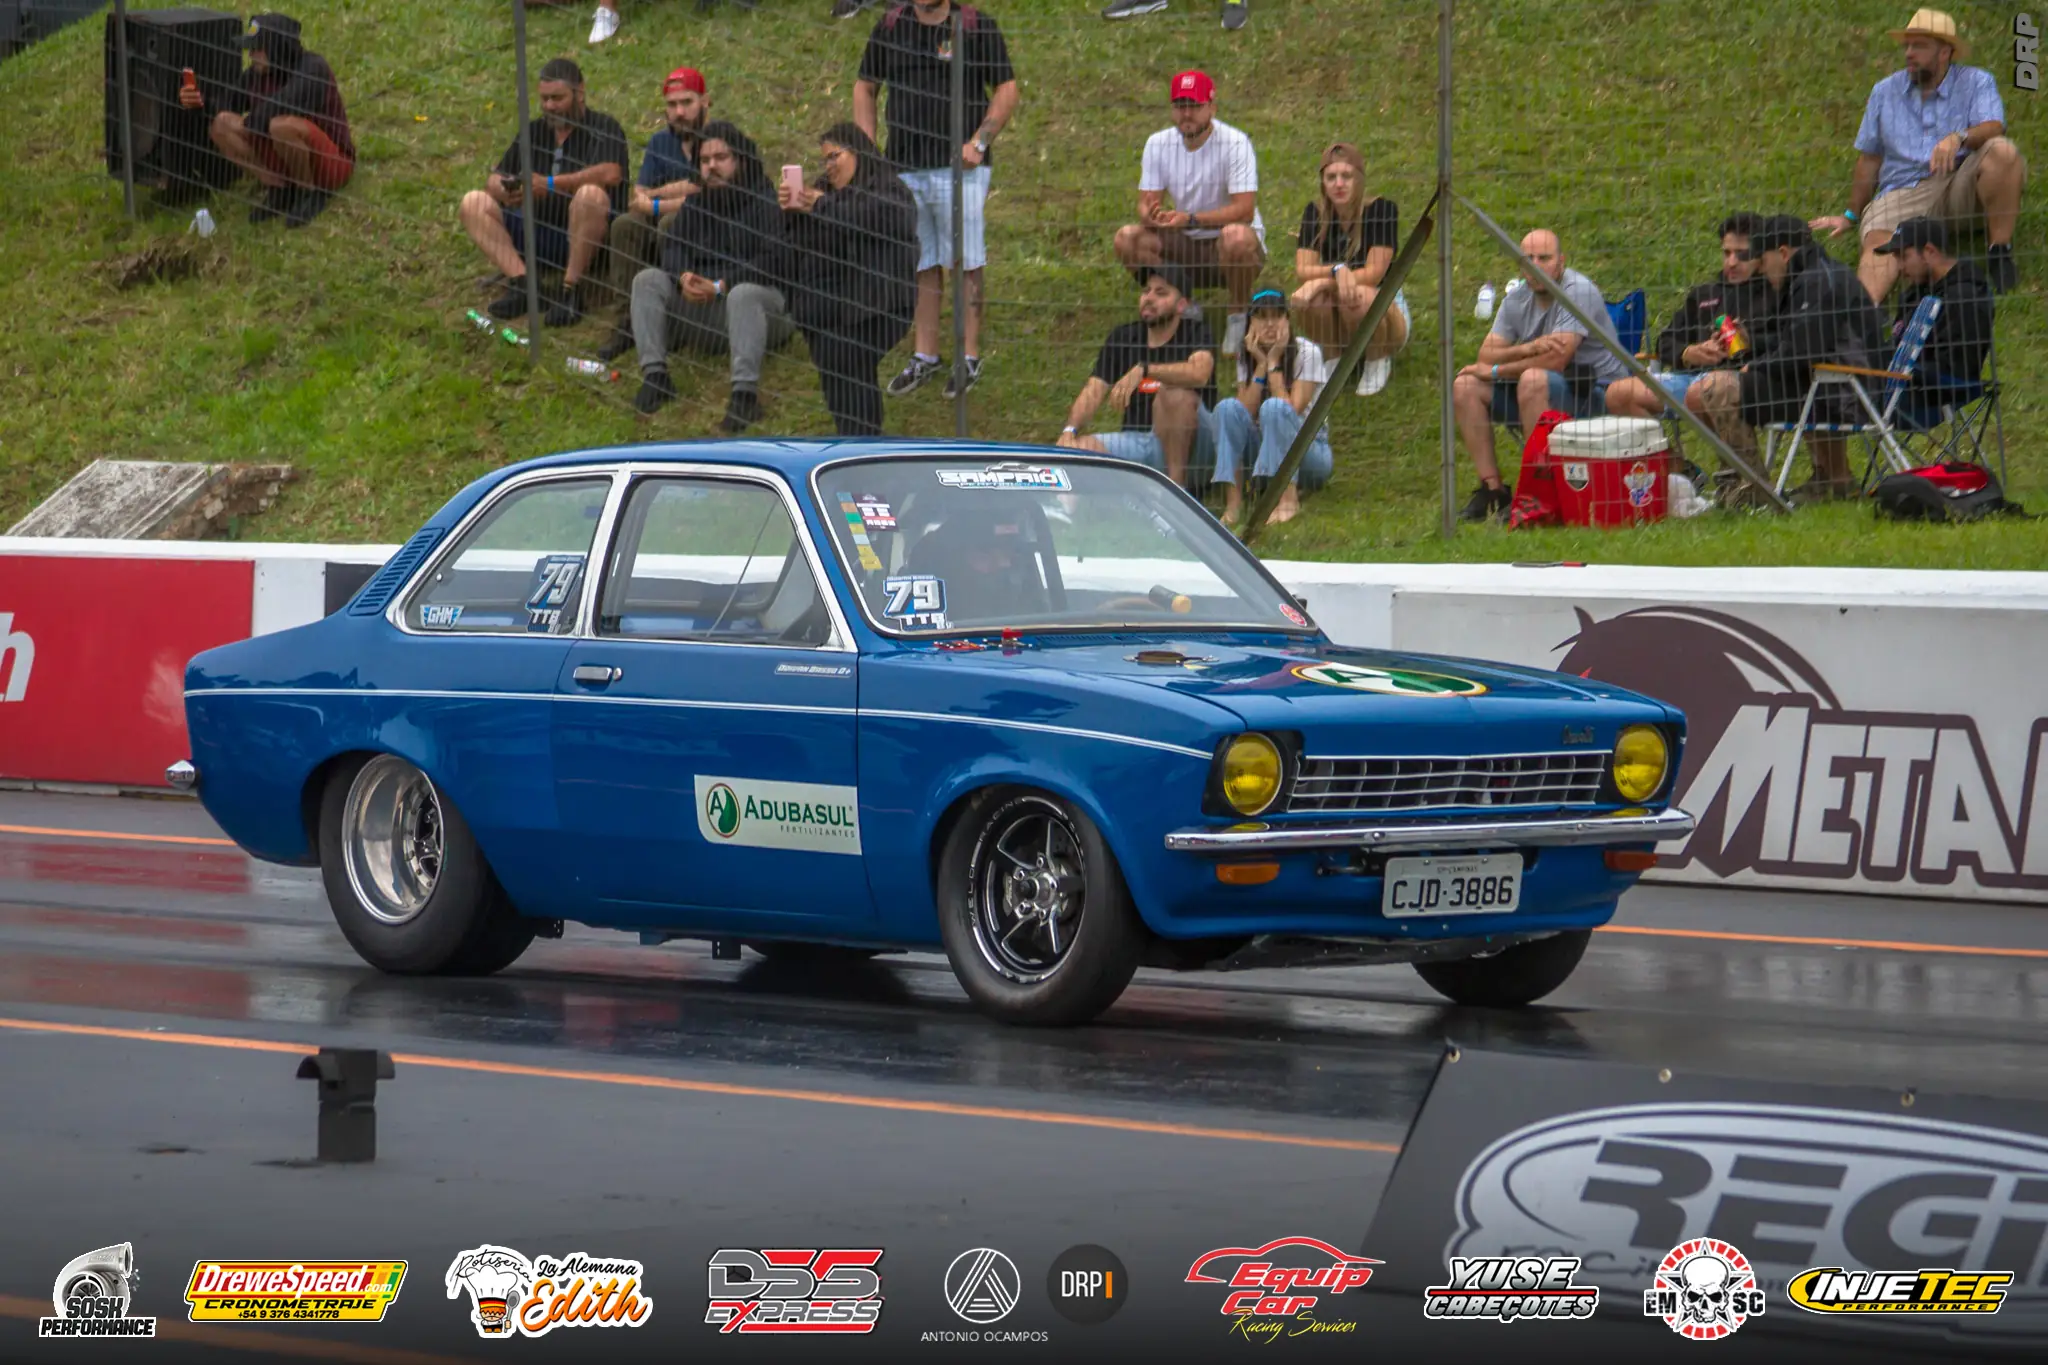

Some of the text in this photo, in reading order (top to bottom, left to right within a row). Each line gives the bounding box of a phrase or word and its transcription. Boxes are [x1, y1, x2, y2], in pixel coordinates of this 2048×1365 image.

[940, 471, 1058, 484] SAMPAIO
[530, 563, 581, 604] 79
[885, 579, 941, 613] 79
[428, 606, 454, 626] GHM
[744, 795, 855, 827] ADUBASUL
[780, 825, 855, 838] FERTILIZANTES
[1580, 1139, 2048, 1284] REGI
